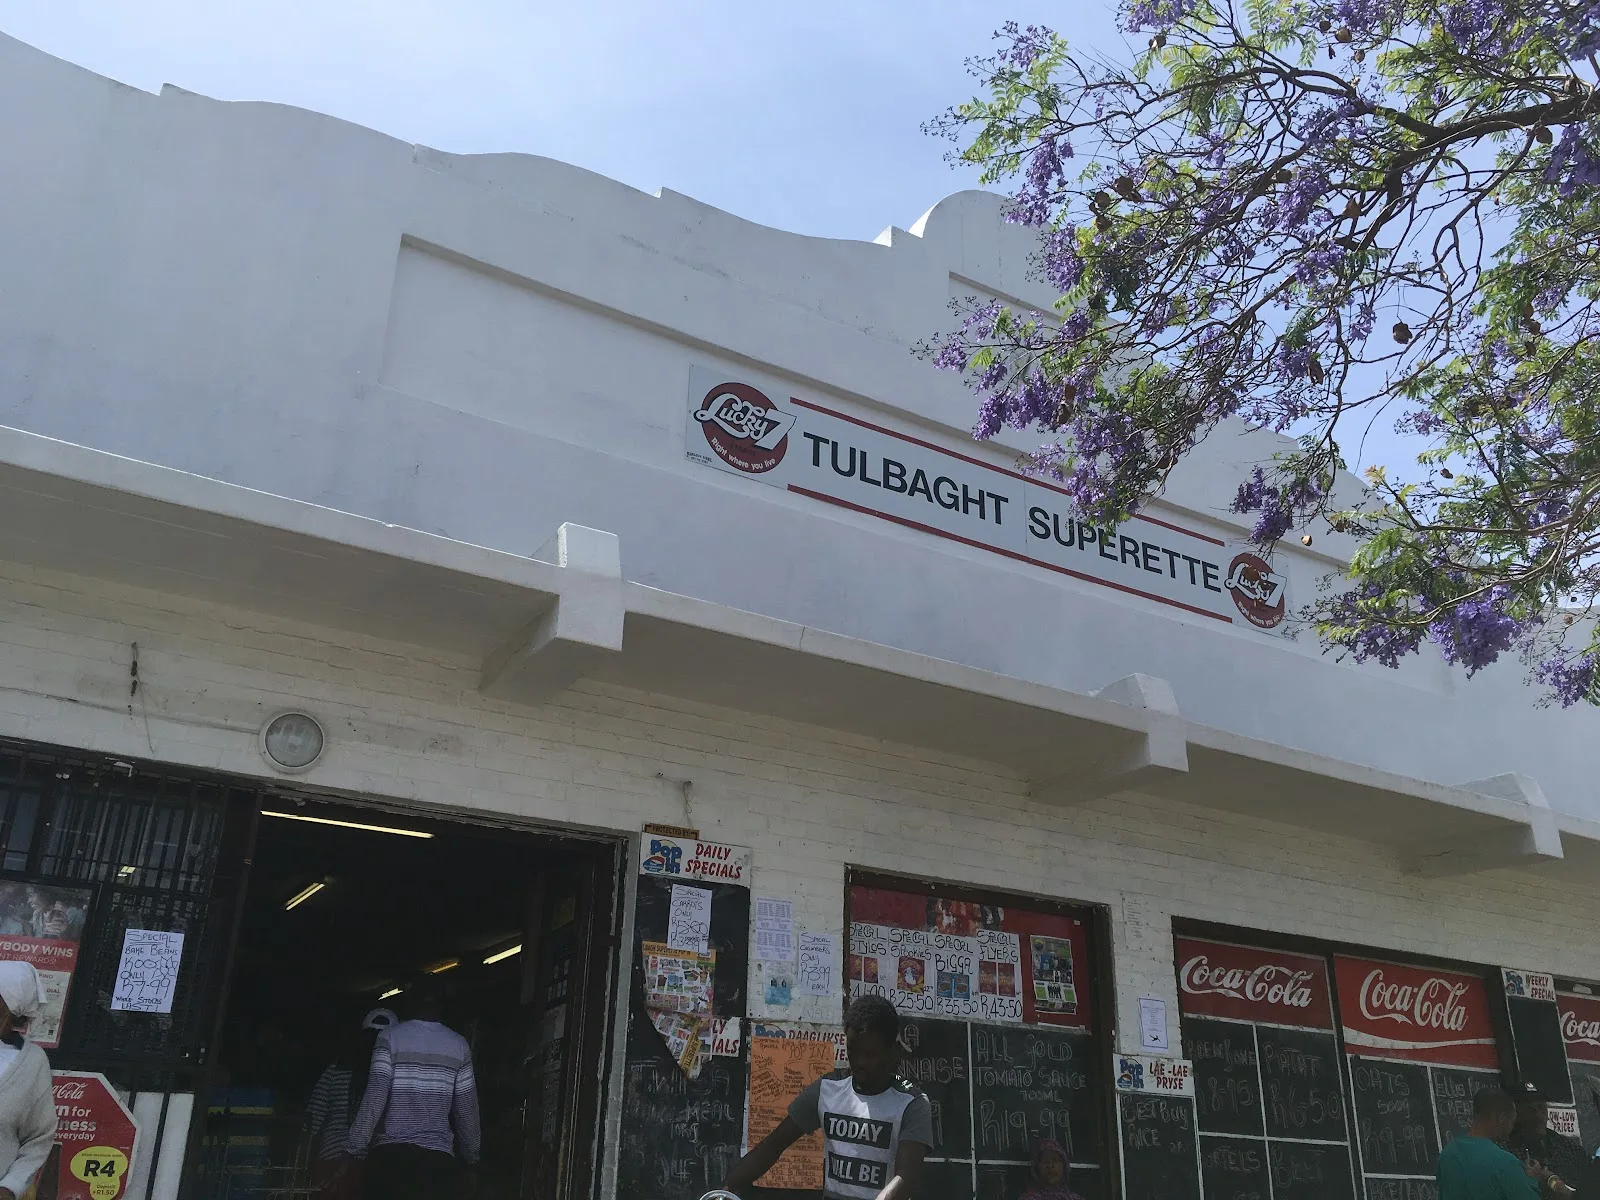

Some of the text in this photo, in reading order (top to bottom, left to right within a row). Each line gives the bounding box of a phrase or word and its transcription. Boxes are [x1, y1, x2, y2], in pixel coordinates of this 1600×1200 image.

[696, 393, 797, 450] Lucky 7
[711, 437, 776, 470] Right where you live
[803, 432, 1222, 593] TULBAGHT SUPERETTE
[653, 825, 681, 836] PROTECTED
[696, 843, 731, 860] DAILY
[685, 860, 742, 879] SPECIALS
[42, 946, 75, 958] WINS
[150, 944, 178, 955] BEANS
[13, 954, 57, 966] REWARDS!
[1180, 955, 1314, 1008] Coca-Cola
[1526, 974, 1548, 987] WEEKLY
[1360, 969, 1470, 1031] Coca-Cola
[1531, 987, 1555, 1000] SPECIAL
[975, 1029, 1014, 1063] ALL
[972, 1065, 1089, 1090] TOMATO SAUCE
[1156, 1076, 1184, 1090] PRYSE
[1355, 1066, 1410, 1096] OATS
[72, 1106, 91, 1117] for
[829, 1117, 883, 1142] TODAY
[1553, 1122, 1575, 1133] PRICES
[84, 1159, 115, 1178] R4
[859, 1163, 881, 1185] BE
